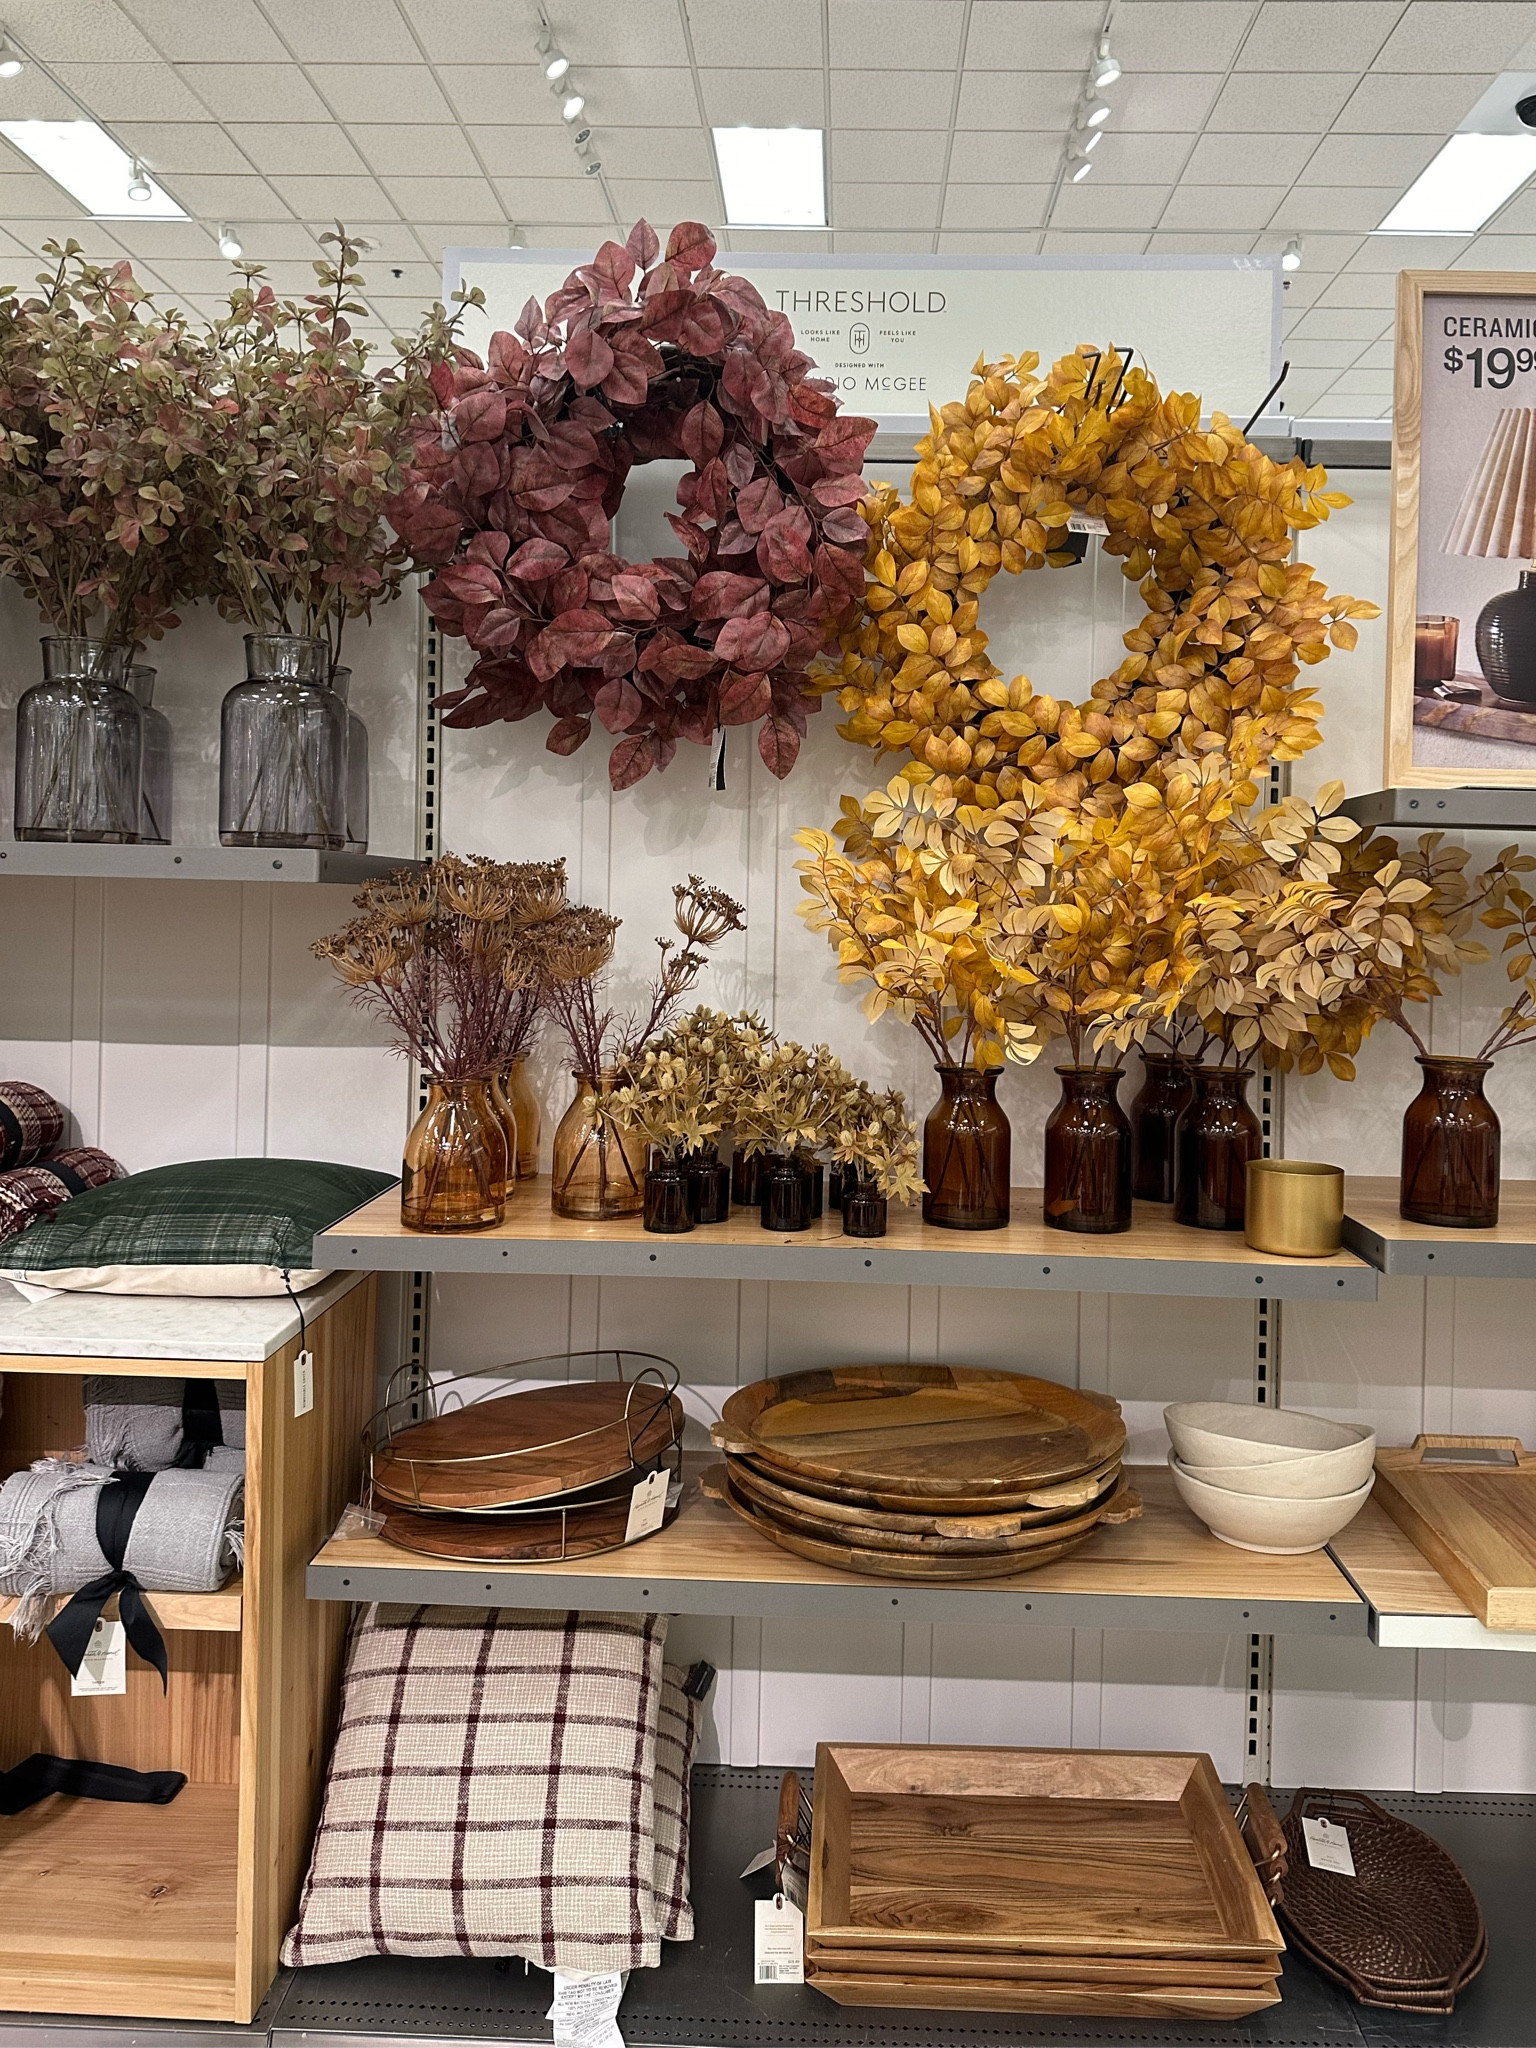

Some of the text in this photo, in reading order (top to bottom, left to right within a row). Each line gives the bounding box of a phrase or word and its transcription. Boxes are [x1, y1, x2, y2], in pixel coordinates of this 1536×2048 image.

[775, 290, 946, 313] THRESHOLD
[1443, 316, 1536, 338] CERAMI
[1443, 345, 1536, 389] $199
